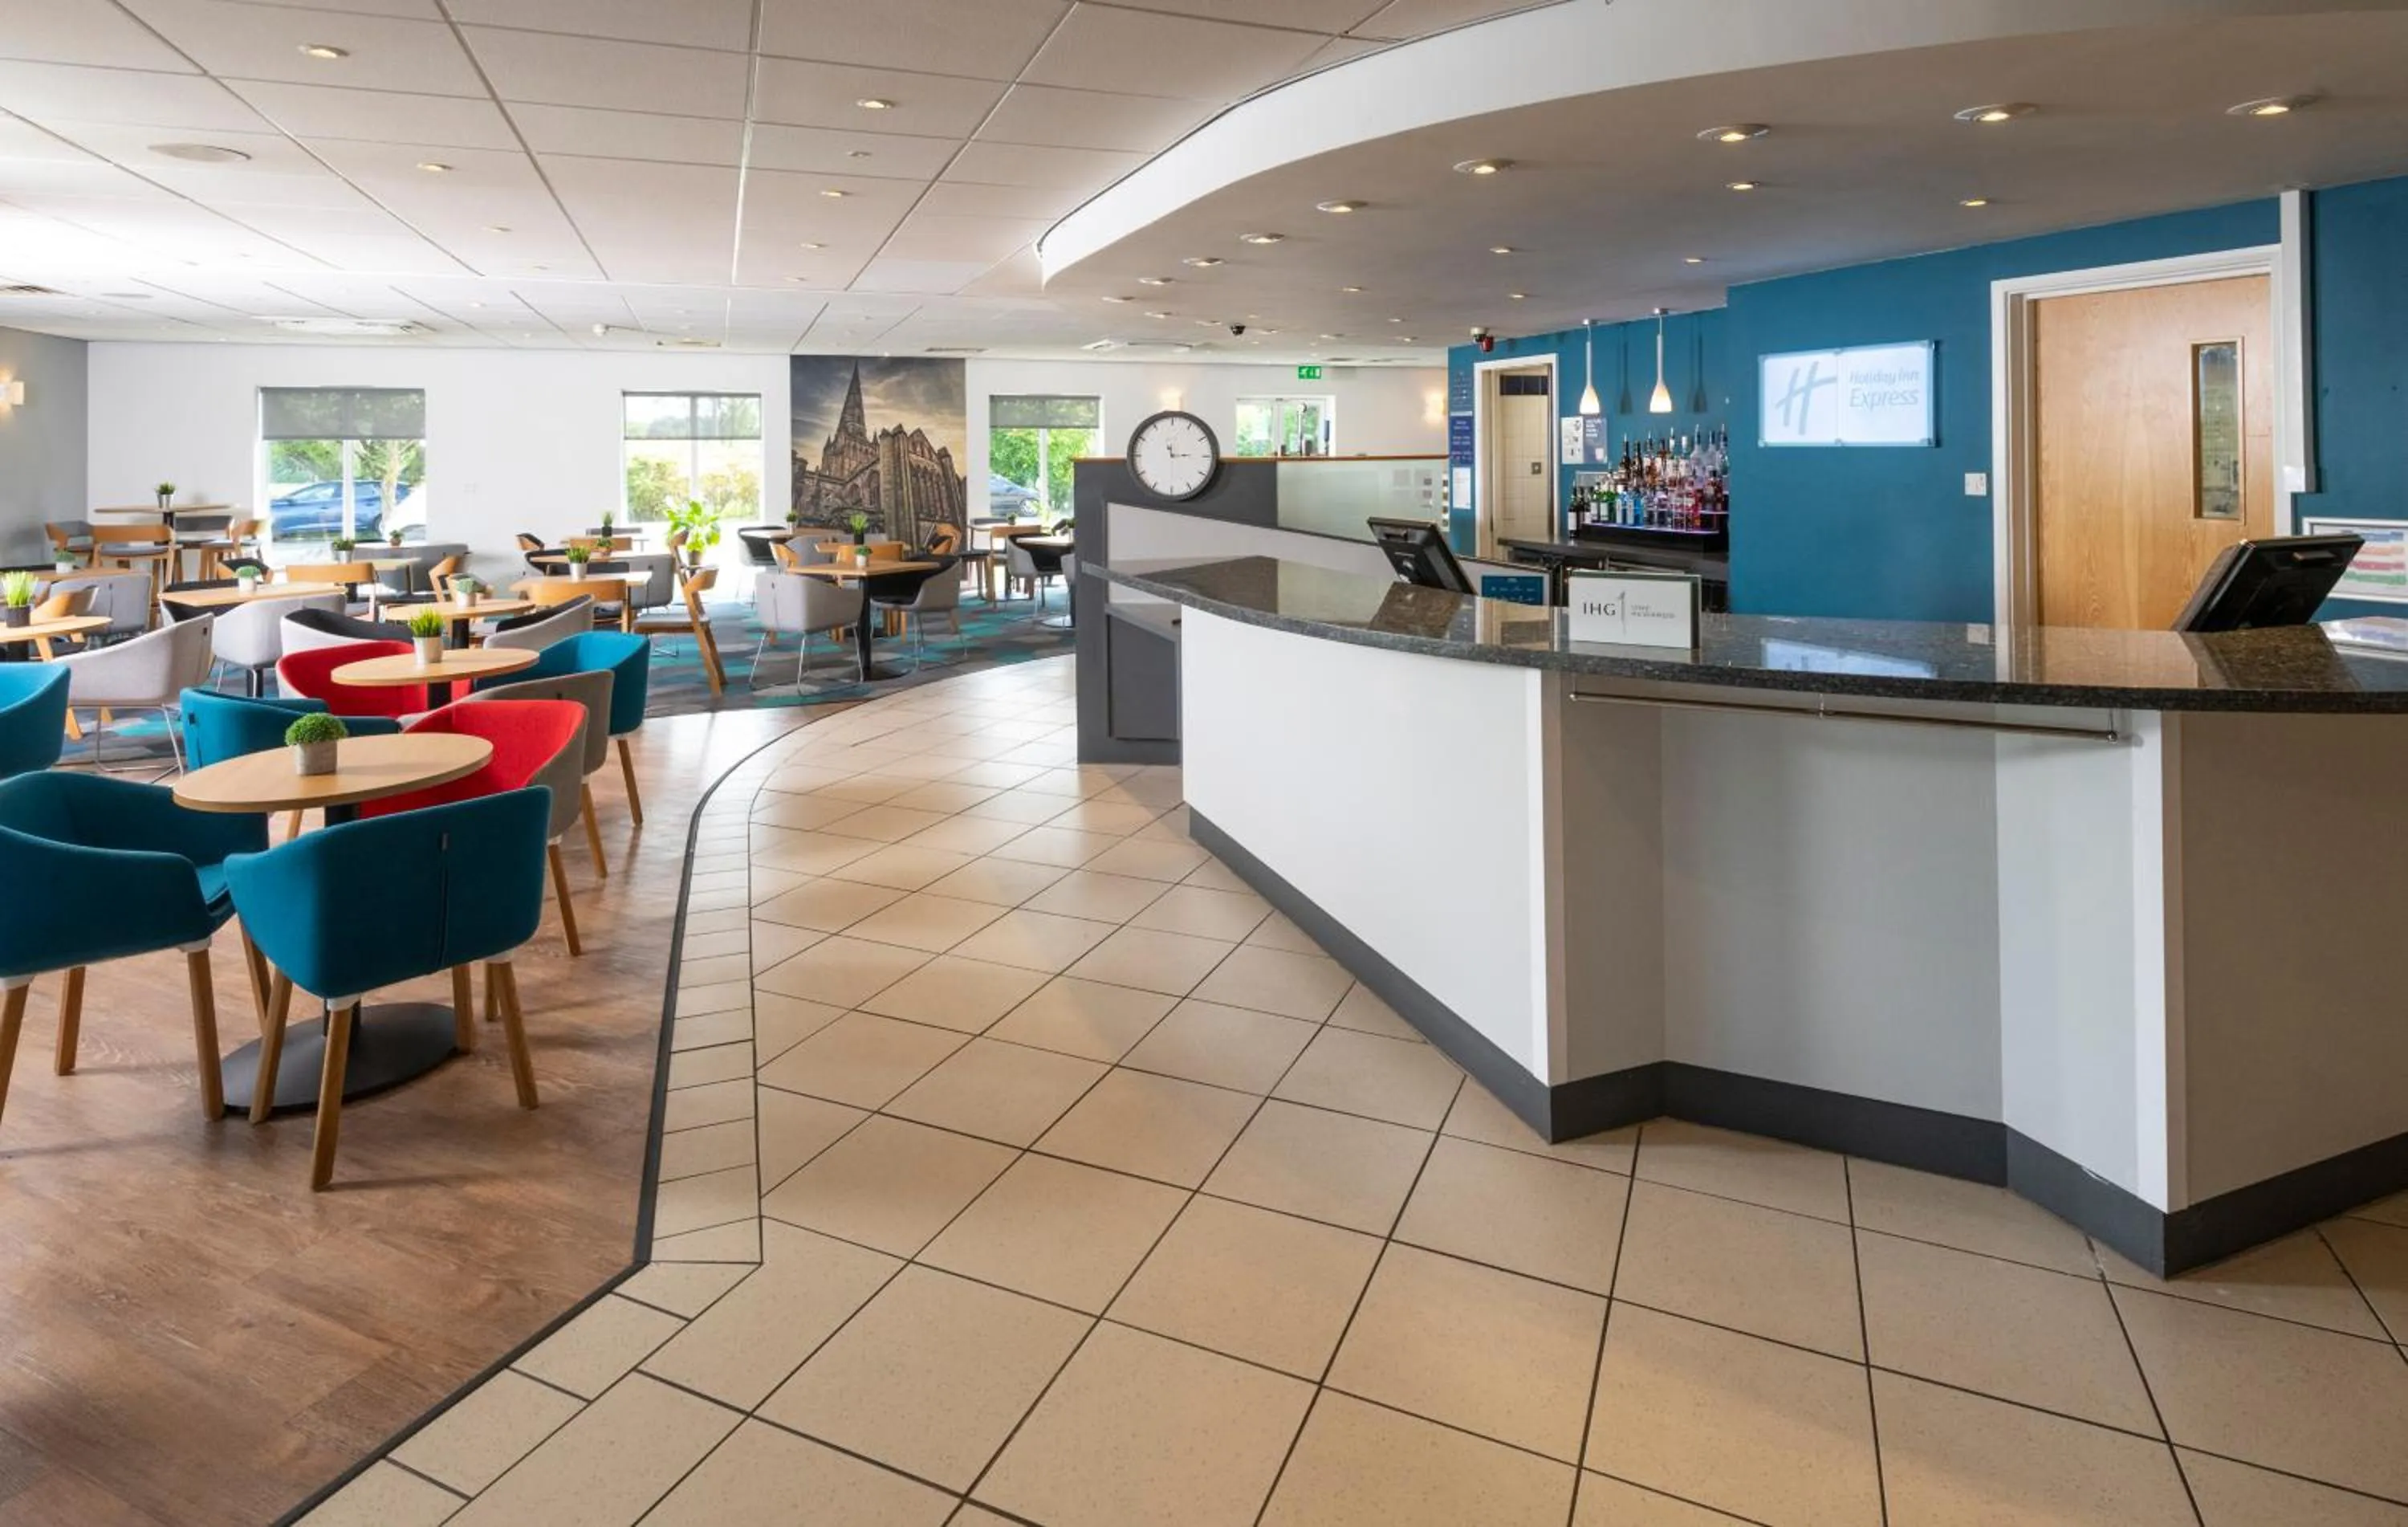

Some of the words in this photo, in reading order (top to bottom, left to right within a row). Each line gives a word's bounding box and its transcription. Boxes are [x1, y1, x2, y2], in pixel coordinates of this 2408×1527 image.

[1849, 369, 1896, 385] Holiday
[1849, 388, 1919, 411] Express
[1583, 602, 1616, 616] IHG
